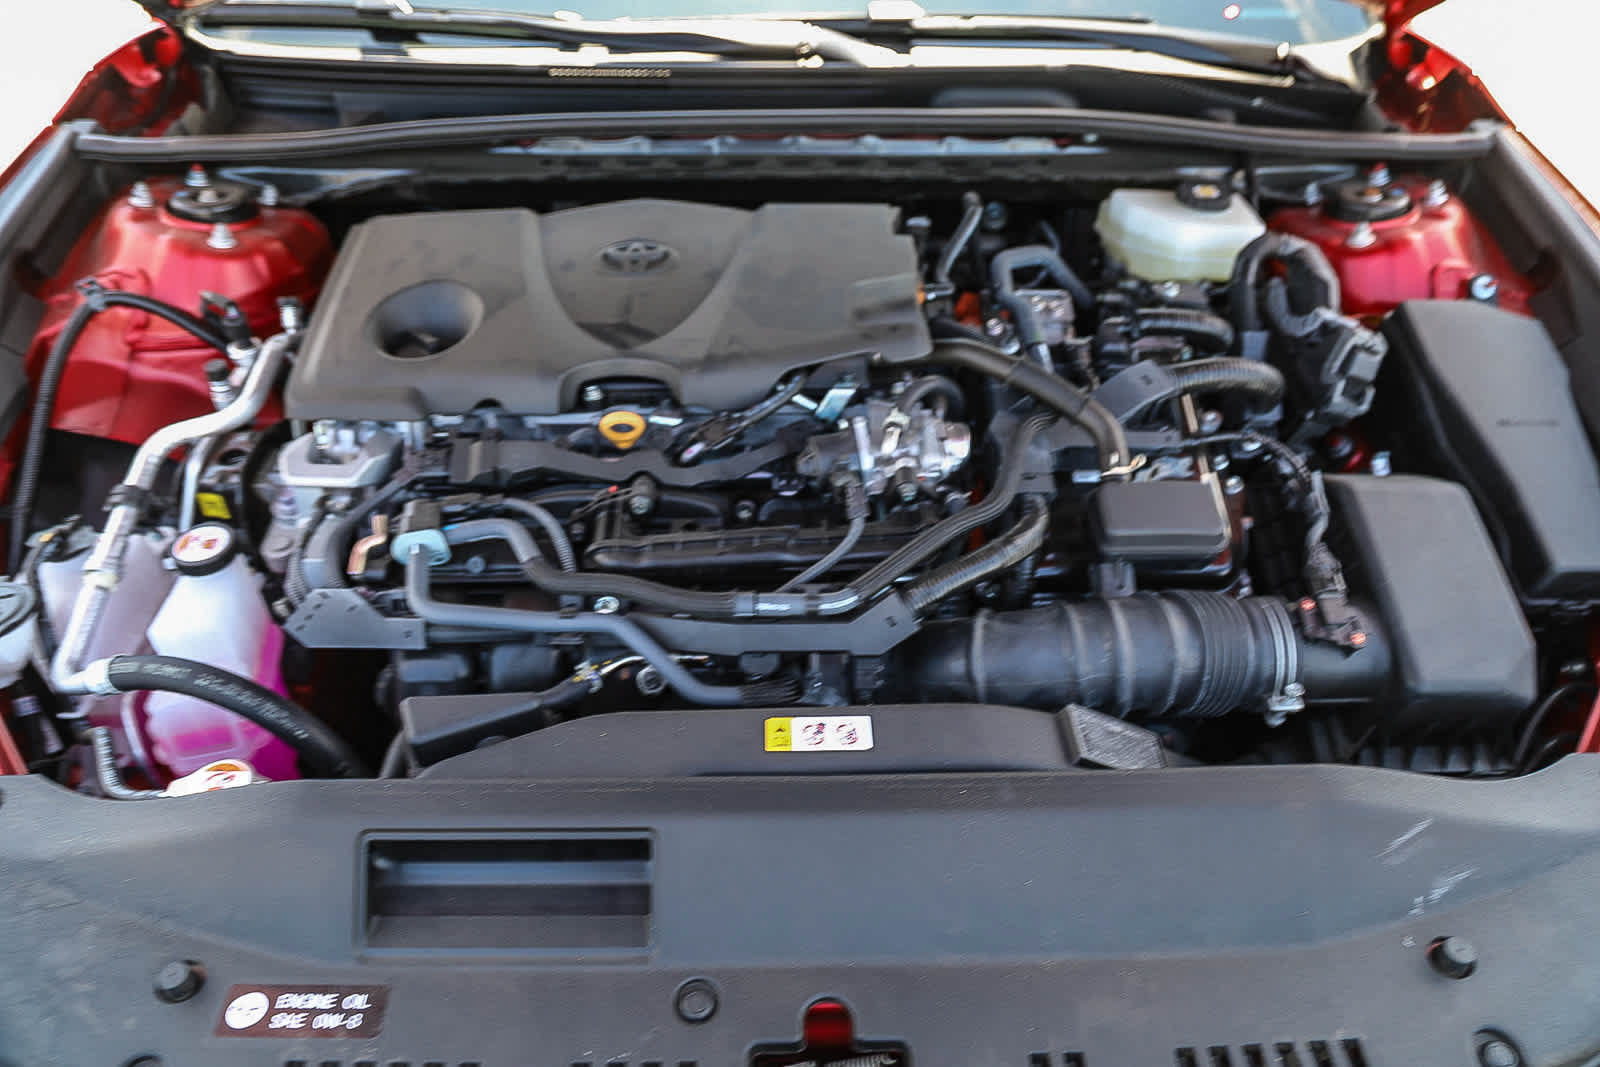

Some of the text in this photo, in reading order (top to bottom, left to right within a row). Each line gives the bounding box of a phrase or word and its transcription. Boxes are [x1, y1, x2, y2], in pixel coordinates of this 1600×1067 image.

[274, 993, 372, 1010] ENGINE OIL
[268, 1012, 310, 1029] SAE
